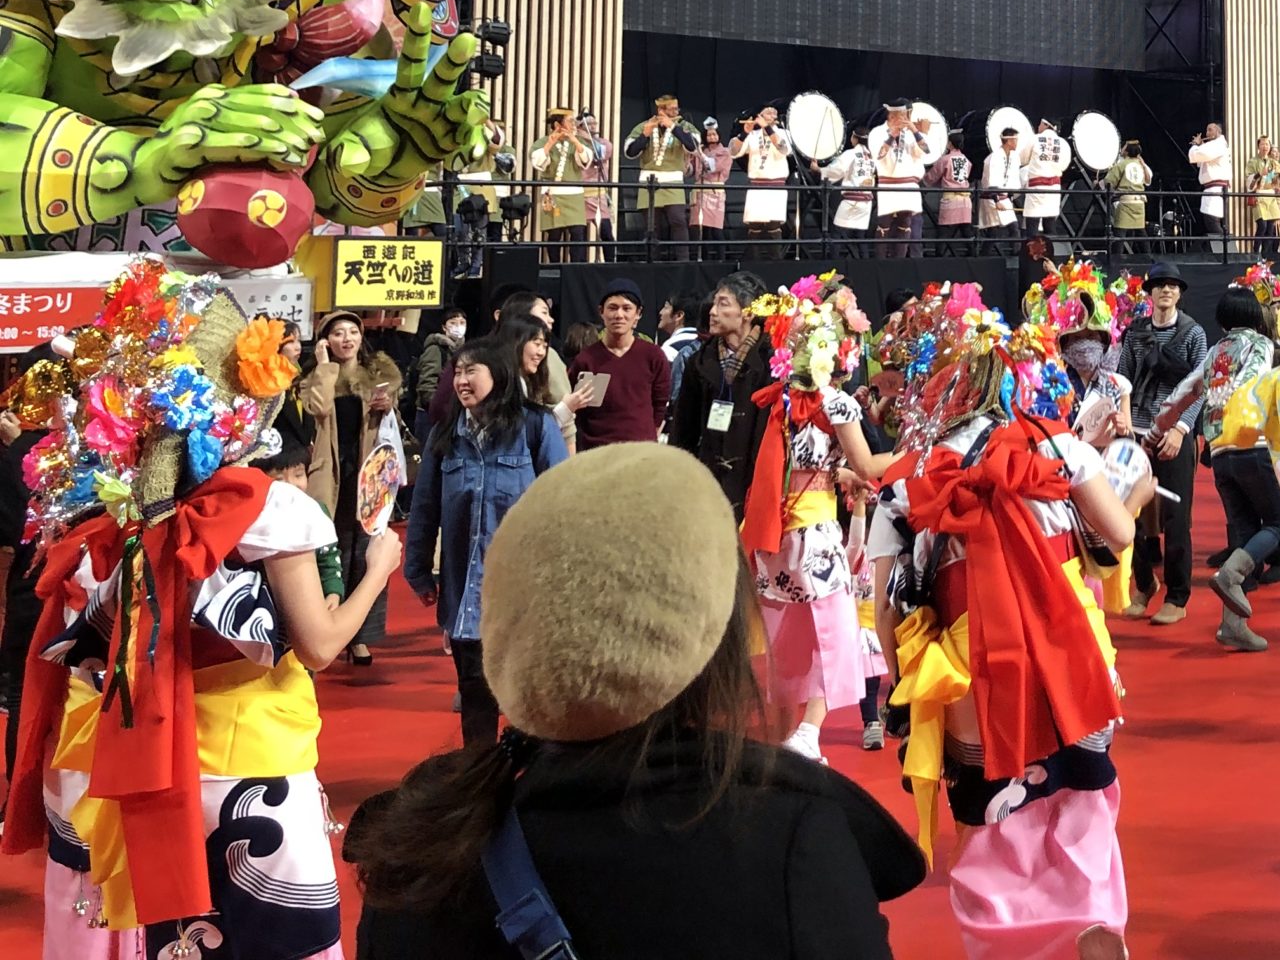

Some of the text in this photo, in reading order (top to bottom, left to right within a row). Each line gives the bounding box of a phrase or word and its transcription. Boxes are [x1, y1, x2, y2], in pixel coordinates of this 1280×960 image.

[362, 245, 416, 260] 西遊記
[343, 260, 434, 285] 天竺への道
